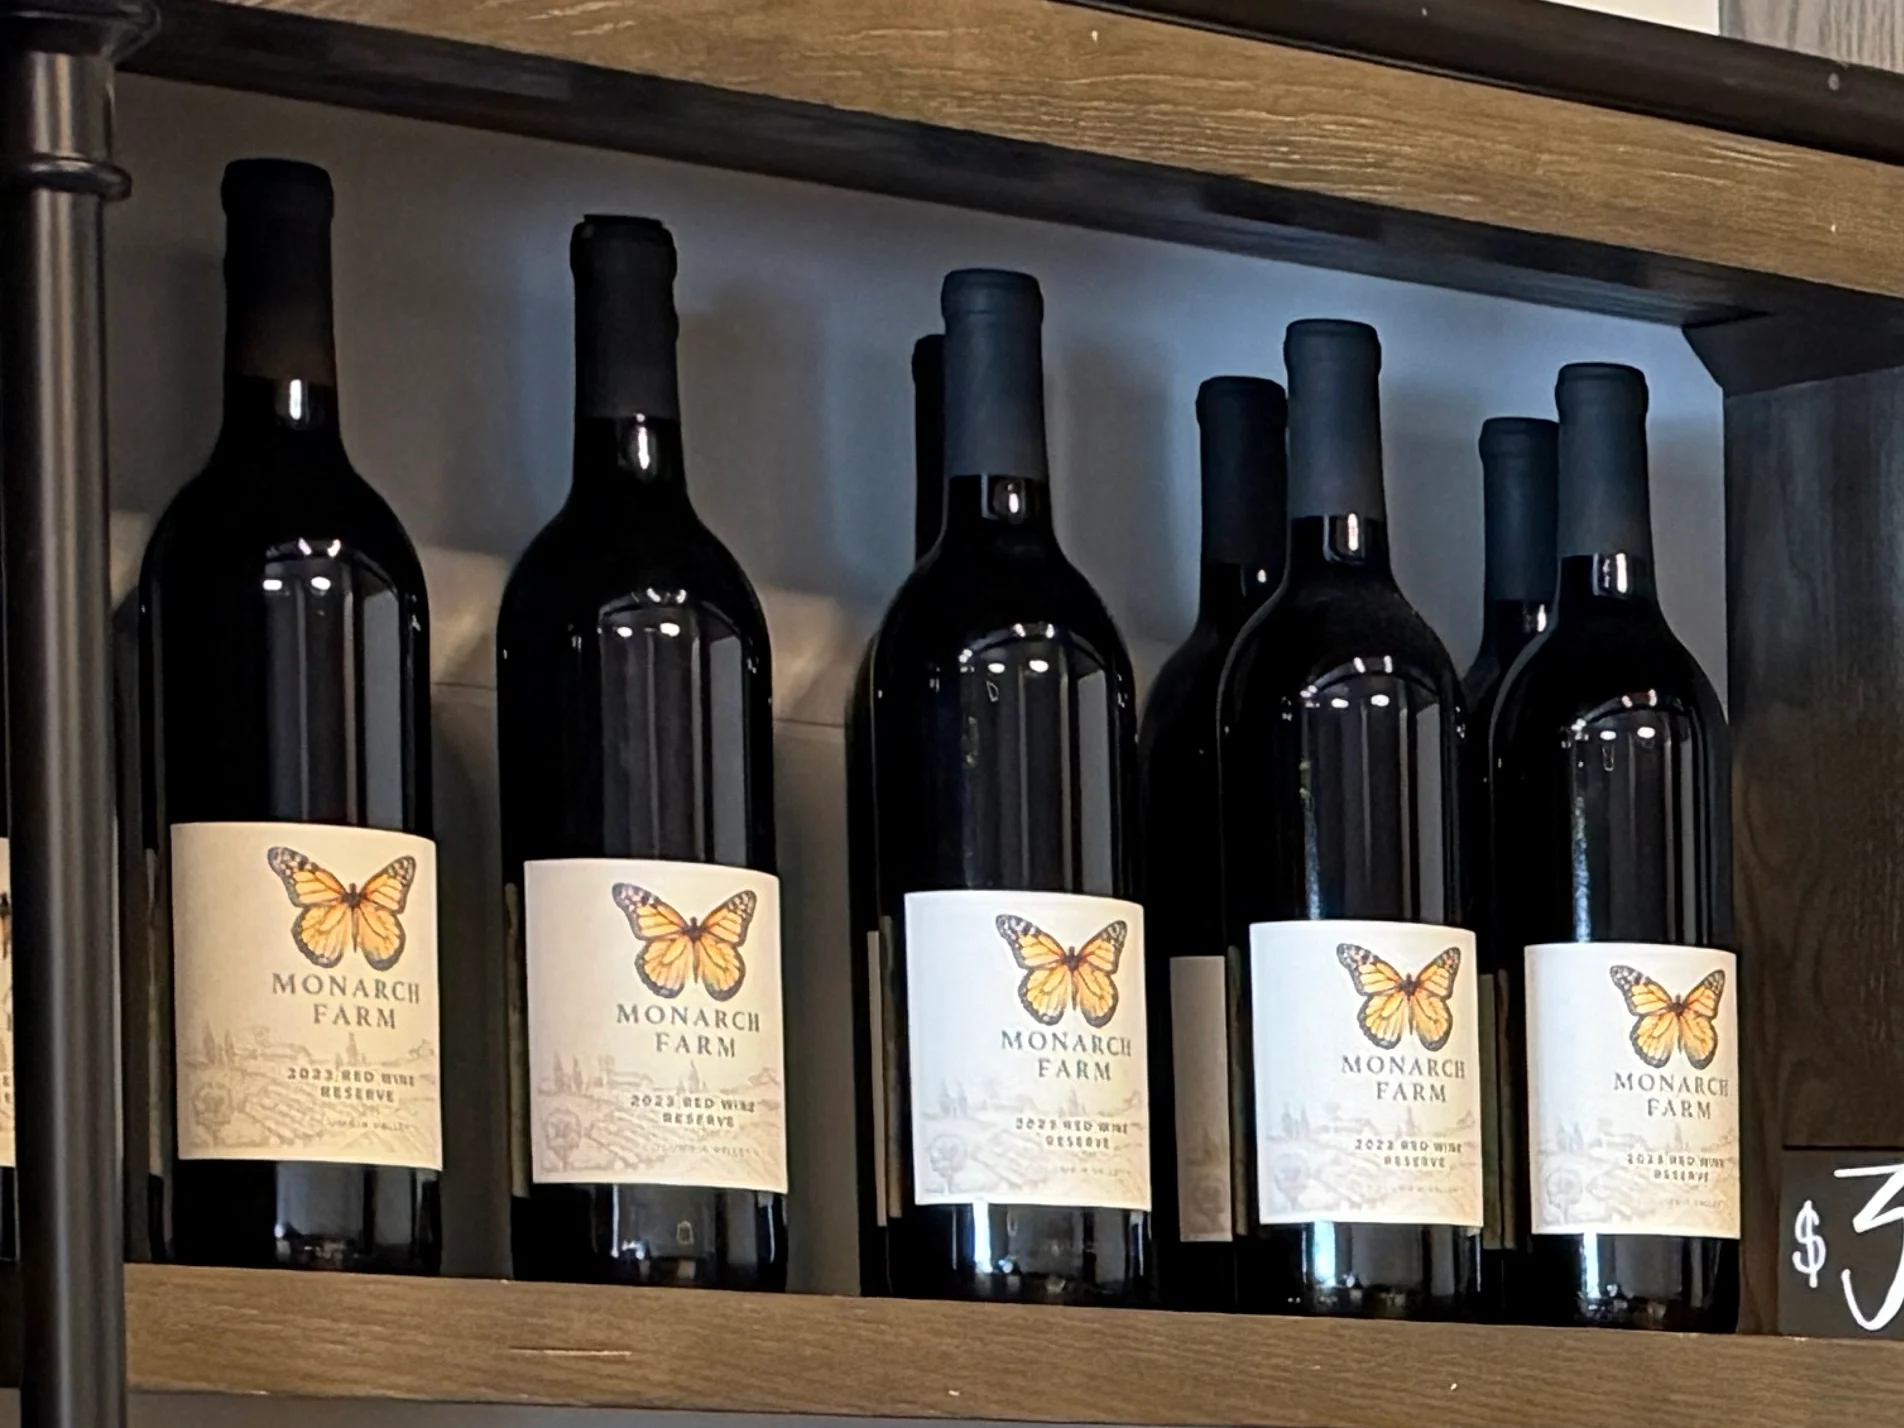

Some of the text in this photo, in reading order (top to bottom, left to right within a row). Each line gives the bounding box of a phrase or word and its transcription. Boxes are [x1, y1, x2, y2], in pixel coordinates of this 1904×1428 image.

[272, 973, 419, 1004] MONARCH
[313, 1004, 397, 1029] FARM
[616, 1004, 760, 1032] MONARCH
[655, 1032, 736, 1058] FARM
[1001, 1030, 1132, 1057] MONARCH
[1037, 1058, 1113, 1081] FARM
[1341, 1055, 1466, 1079] MONARCH
[1376, 1081, 1447, 1103] FARM
[1613, 1072, 1729, 1098] MONARCH
[1647, 1098, 1712, 1120] FARM
